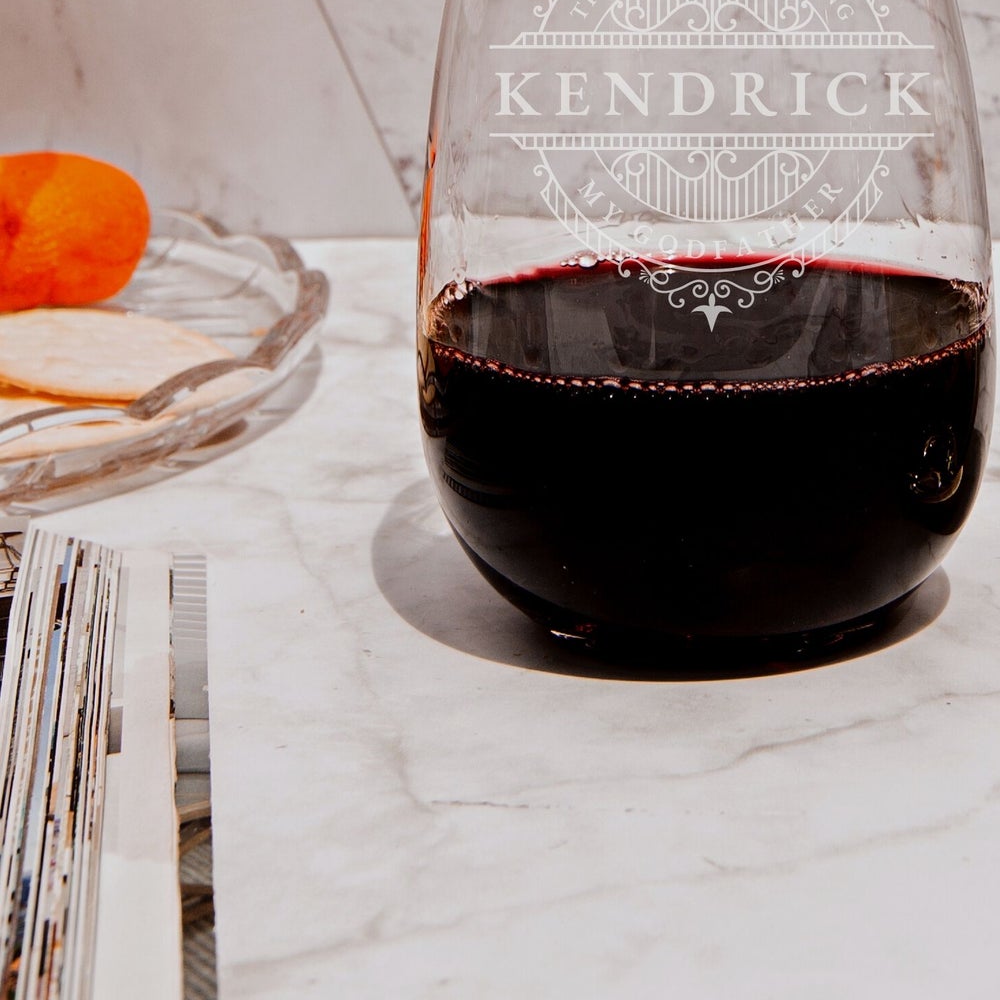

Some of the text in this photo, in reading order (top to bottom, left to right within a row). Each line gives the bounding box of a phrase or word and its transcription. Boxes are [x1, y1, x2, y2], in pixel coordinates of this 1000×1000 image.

[494, 71, 931, 116] KENDRICK
[577, 178, 844, 260] MY GODFATHER
